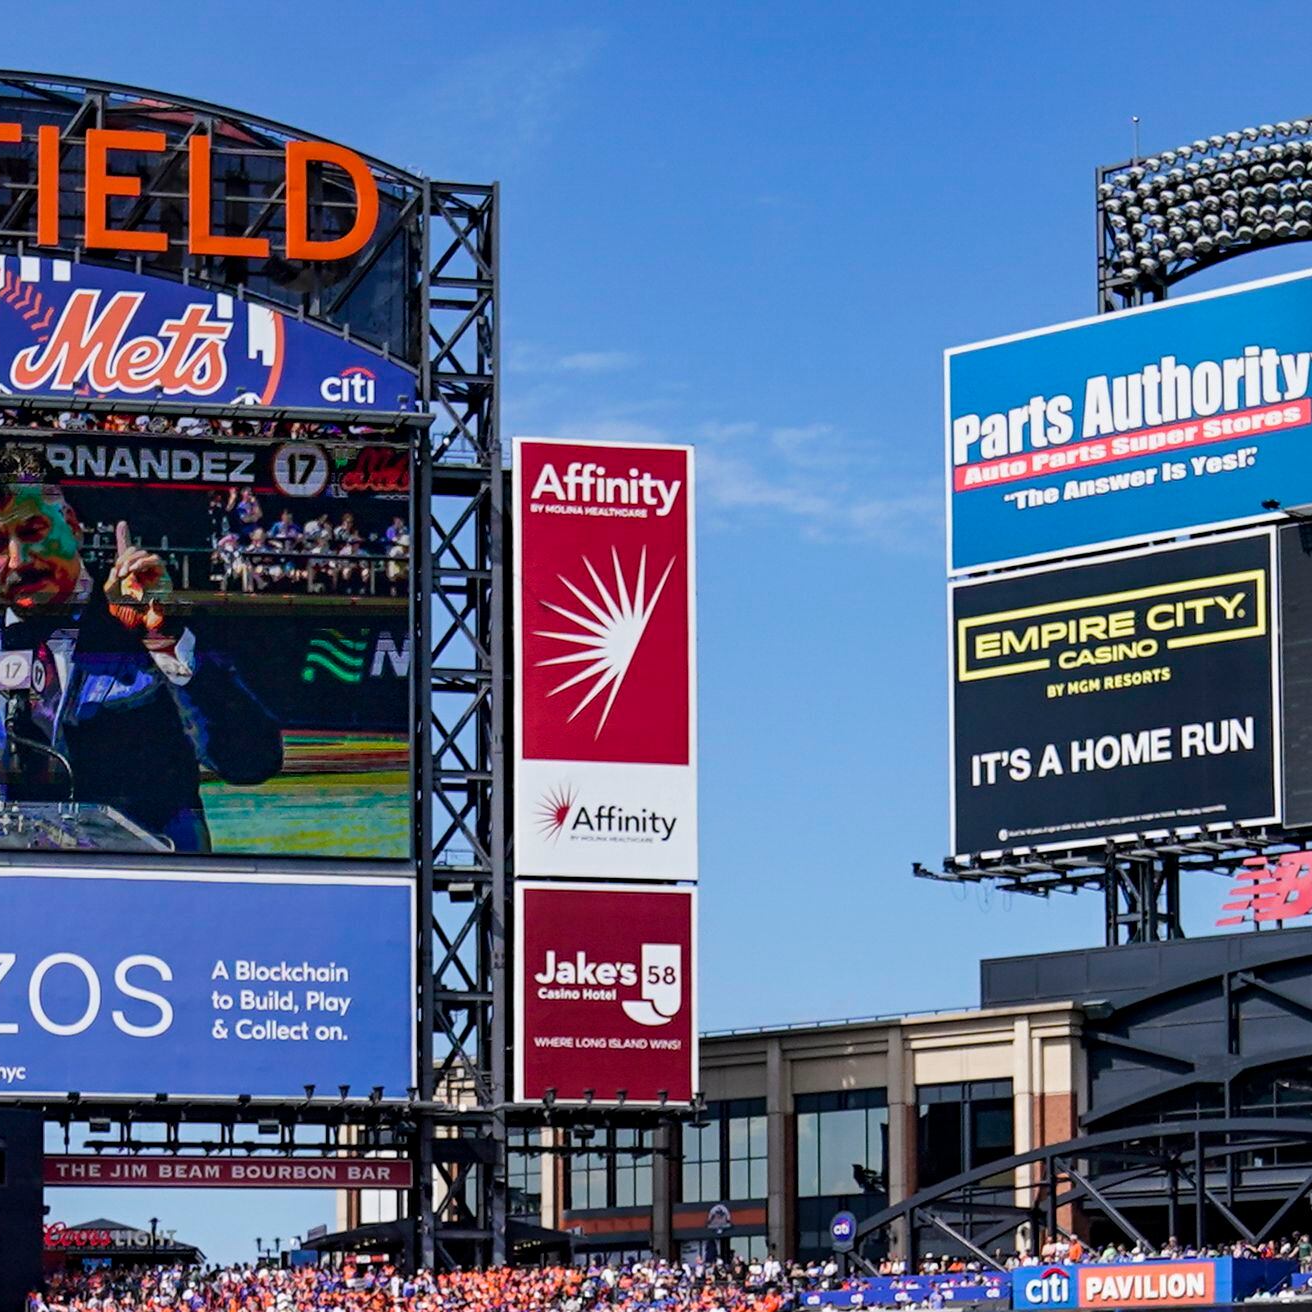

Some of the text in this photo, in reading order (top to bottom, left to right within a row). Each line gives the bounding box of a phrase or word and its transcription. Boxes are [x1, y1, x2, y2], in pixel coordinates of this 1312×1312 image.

[10, 288, 235, 396] Mets
[320, 373, 375, 405] citi
[953, 345, 1311, 468] Parts Authority
[964, 405, 1301, 487] Auto Parts Super Stores
[287, 452, 317, 487] 17
[1063, 465, 1157, 501] Answer
[1162, 460, 1186, 482] Is
[531, 462, 681, 517] Affinity
[975, 592, 1247, 660] EMPIRE CITY
[1059, 638, 1158, 671] CASINO
[1046, 666, 1171, 699] BY MGM RESORTS
[971, 716, 1255, 787] IT'S A HOME RUN
[571, 805, 677, 842] Affinity
[211, 959, 349, 983] A Blockchain
[534, 950, 677, 986] Jake's 58
[211, 990, 351, 1017] to Build, Play
[537, 986, 617, 1001] Casino Hotel
[211, 1018, 349, 1042] & Collect on.
[534, 1036, 682, 1051] WHERE LONG ISLAND WINS!
[55, 1163, 391, 1182] THE JIM BEAM BOURBON BAR
[1024, 1271, 1205, 1304] citi PAVILION
